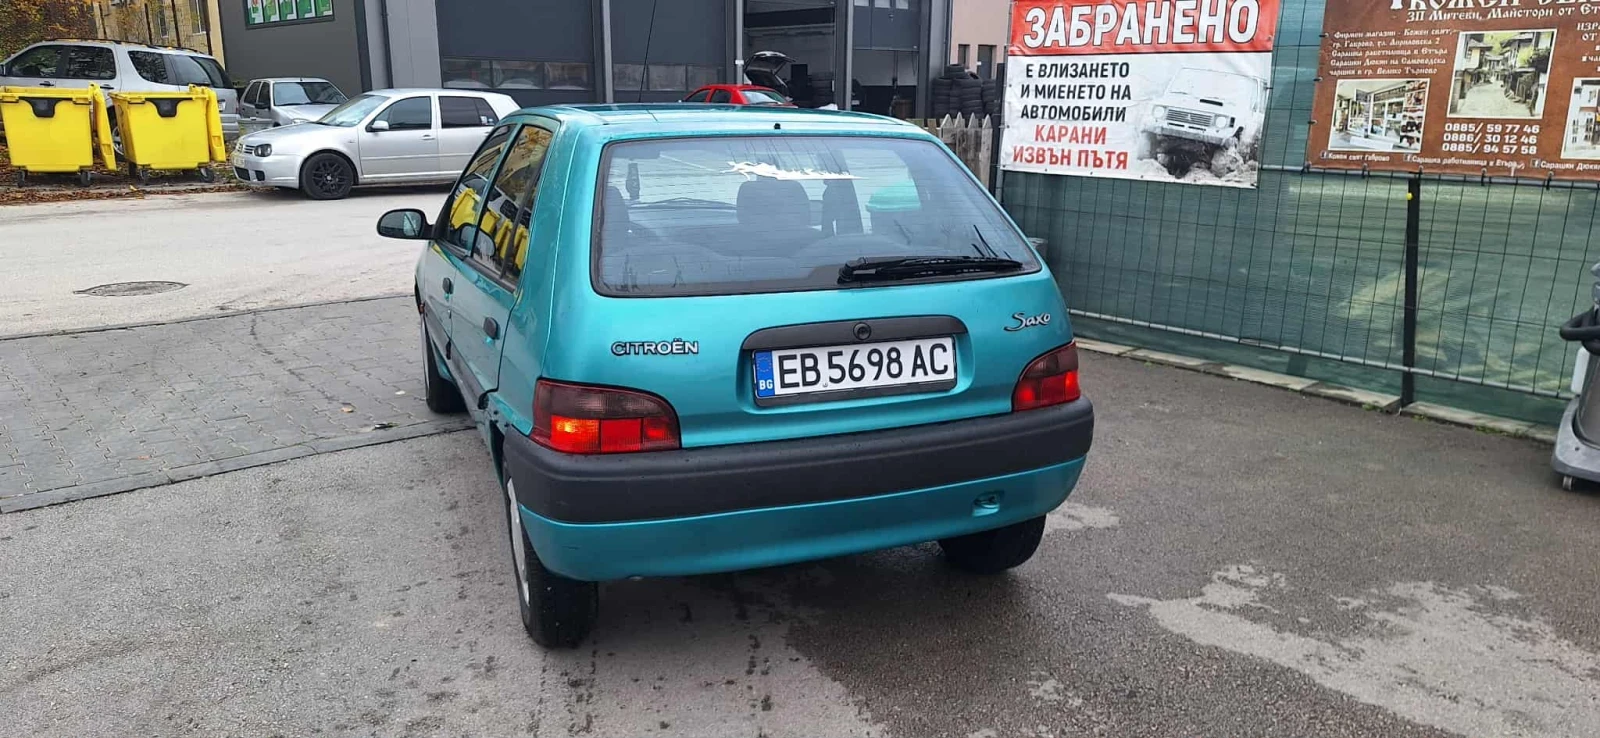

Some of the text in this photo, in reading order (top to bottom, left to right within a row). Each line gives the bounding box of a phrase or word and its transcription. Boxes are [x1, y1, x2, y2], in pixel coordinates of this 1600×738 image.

[1406, 11, 1425, 22] ЗП
[1487, 7, 1553, 19] Майстори
[1558, 7, 1576, 16] от
[1023, 0, 1260, 48] ЗАБРАНЕНО
[1026, 62, 1130, 79] Е ВЛИЗАНЕТО
[1021, 84, 1131, 100] И МИЕНЕТО НА
[1021, 105, 1126, 122] АВТОМОБИЛИ
[1035, 124, 1107, 145] КАРАНИ
[1445, 122, 1540, 134] 0885/ 59 77 46
[1443, 132, 1537, 144] 0886/ 30 12 46
[1442, 143, 1537, 154] 0885/ 94 57 58
[1013, 146, 1128, 169] ИЗВЪН ПЪТЯ
[1003, 312, 1051, 331] Saxo
[611, 337, 699, 356] CITROËN
[777, 343, 949, 389] EB 5698 AC
[759, 379, 773, 390] BG
